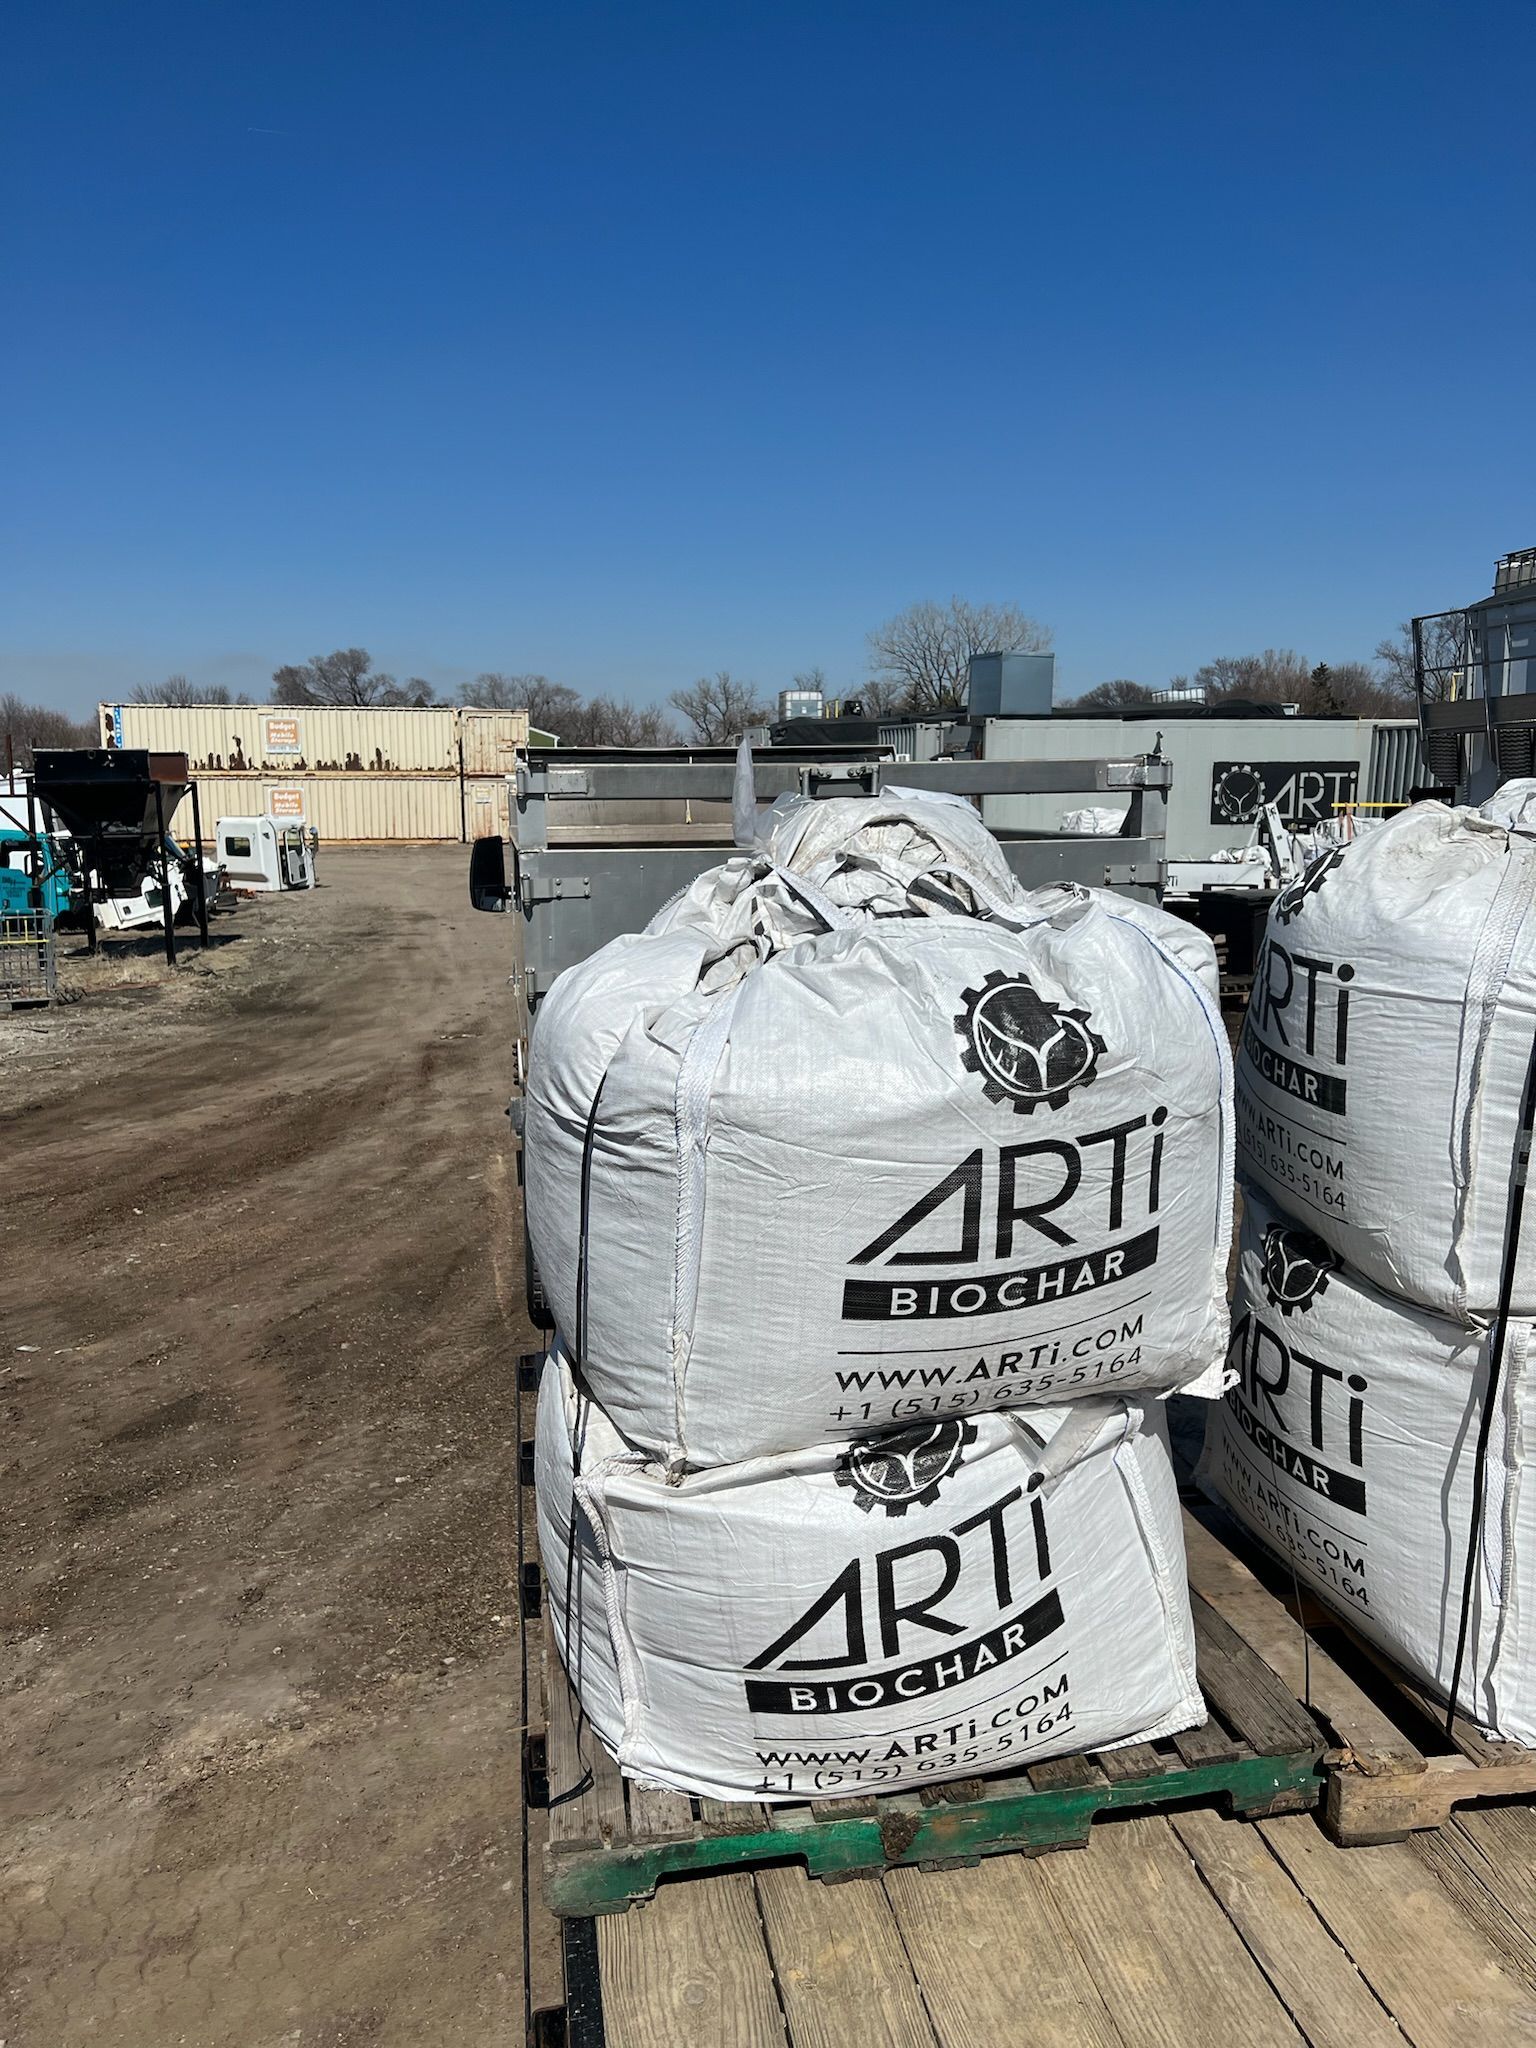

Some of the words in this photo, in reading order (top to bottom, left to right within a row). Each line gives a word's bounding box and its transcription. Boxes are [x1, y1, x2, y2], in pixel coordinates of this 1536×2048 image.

[269, 722, 295, 731] Budget
[273, 792, 299, 801] Budget
[1271, 770, 1358, 819] ARTi
[846, 1105, 1168, 1266] ARTi
[1270, 1154, 1346, 1211] 635-5164
[889, 1249, 1126, 1316] BIOCHAR
[829, 1402, 872, 1421] +1
[891, 1389, 980, 1418] (515)
[994, 1346, 1143, 1400] 635-5164
[835, 1314, 1145, 1393] WWW.ARTi.COM
[1229, 1387, 1331, 1496] BIOCHAR
[742, 1472, 1052, 1672] ARTi
[1276, 1525, 1370, 1606] 635-5164
[788, 1623, 1027, 1712] BIOCHAR
[754, 1773, 793, 1791] +1
[814, 1764, 901, 1790] (515)
[917, 1702, 1073, 1772] 635-5164
[755, 1674, 1069, 1767] WWW.ARTi.COM
